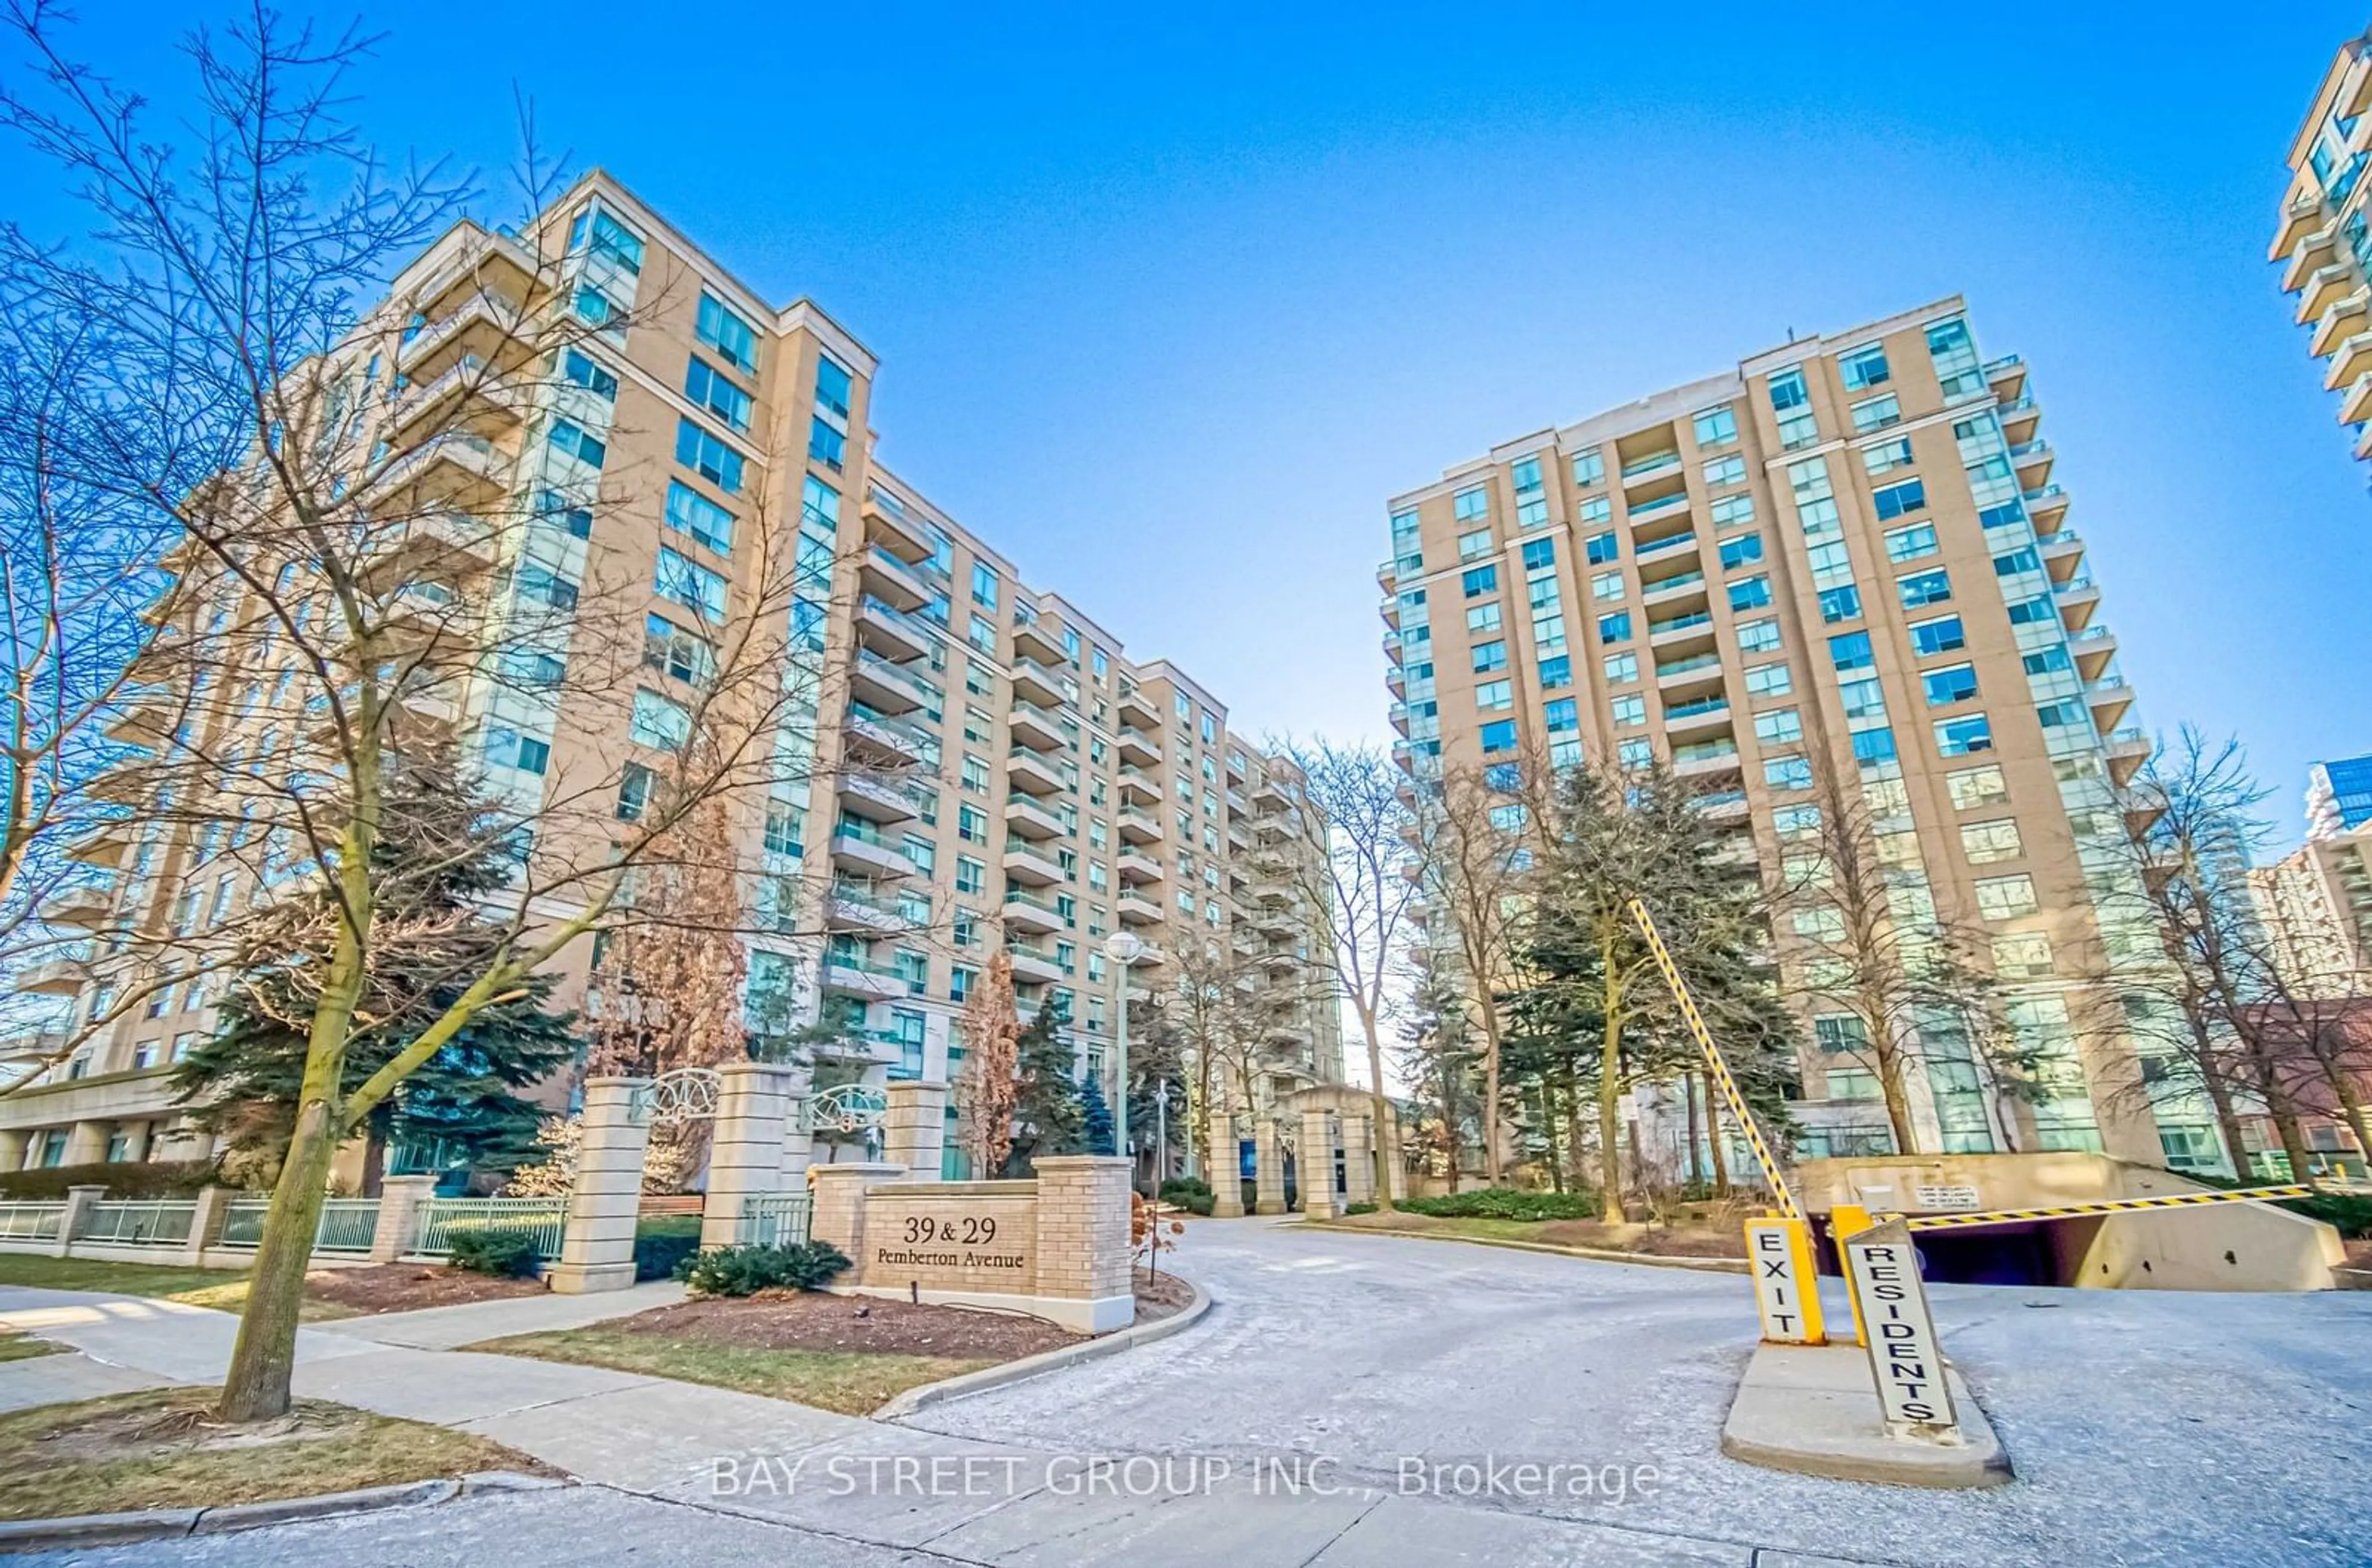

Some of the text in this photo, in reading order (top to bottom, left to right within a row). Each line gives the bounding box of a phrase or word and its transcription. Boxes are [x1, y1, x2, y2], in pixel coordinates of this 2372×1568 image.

[878, 1248, 1024, 1268] Pemberton Avenue
[904, 1217, 996, 1244] 39 & 29
[1759, 1234, 1796, 1333] EXIT
[1863, 1247, 1935, 1420] RESIDENTS
